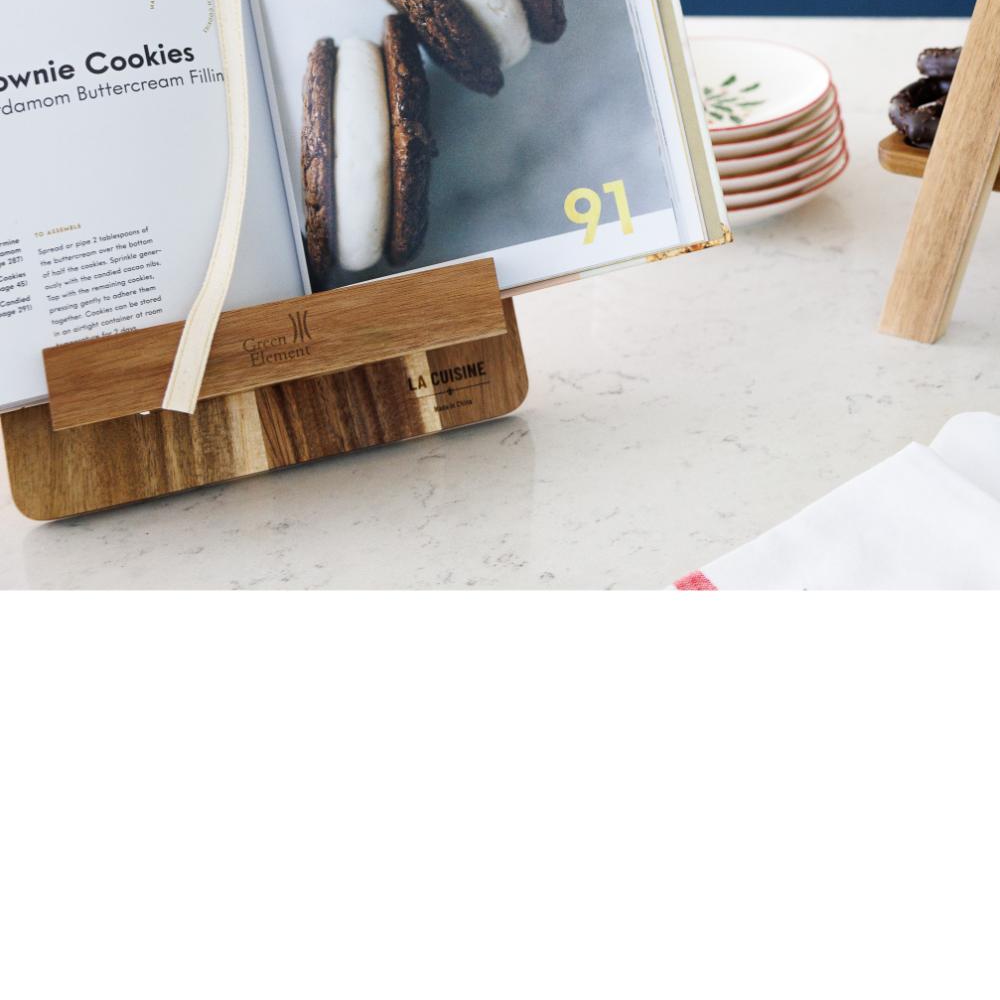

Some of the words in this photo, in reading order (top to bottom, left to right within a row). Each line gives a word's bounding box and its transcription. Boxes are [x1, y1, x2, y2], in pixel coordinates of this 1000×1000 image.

[85, 43, 195, 74] Cookies
[0, 93, 71, 116] damom
[77, 73, 184, 102] Buttercream
[189, 67, 225, 84] Fillin
[564, 179, 634, 245] 91
[38, 244, 64, 256] Spread
[75, 239, 91, 249] pipe
[93, 236, 98, 244] 2
[99, 230, 141, 242] tablespoons
[141, 226, 149, 234] of
[54, 250, 97, 264] buttercream
[99, 246, 114, 255] over
[129, 238, 153, 249] bottom
[42, 270, 51, 279] of
[52, 266, 66, 276] half
[67, 264, 79, 272] the
[109, 253, 138, 264] Sprinkle
[139, 249, 162, 259] gener-
[64, 277, 79, 286] with
[80, 274, 92, 282] the
[94, 268, 122, 279] candied
[123, 264, 144, 273] cacao
[49, 303, 79, 315] pressing
[80, 296, 102, 308] gently
[112, 289, 137, 299] adhere
[139, 285, 157, 295] them
[62, 289, 76, 298] with
[91, 280, 126, 291] remaining
[73, 321, 99, 333] airtight
[101, 314, 134, 327] container
[135, 311, 143, 319] at
[145, 308, 163, 317] room
[85, 307, 113, 318] Cookies
[129, 300, 138, 308] be
[140, 295, 162, 306] stored
[243, 335, 288, 353] Green
[250, 345, 312, 367] Element
[408, 374, 427, 392] LA
[431, 361, 487, 386] CUISINE
